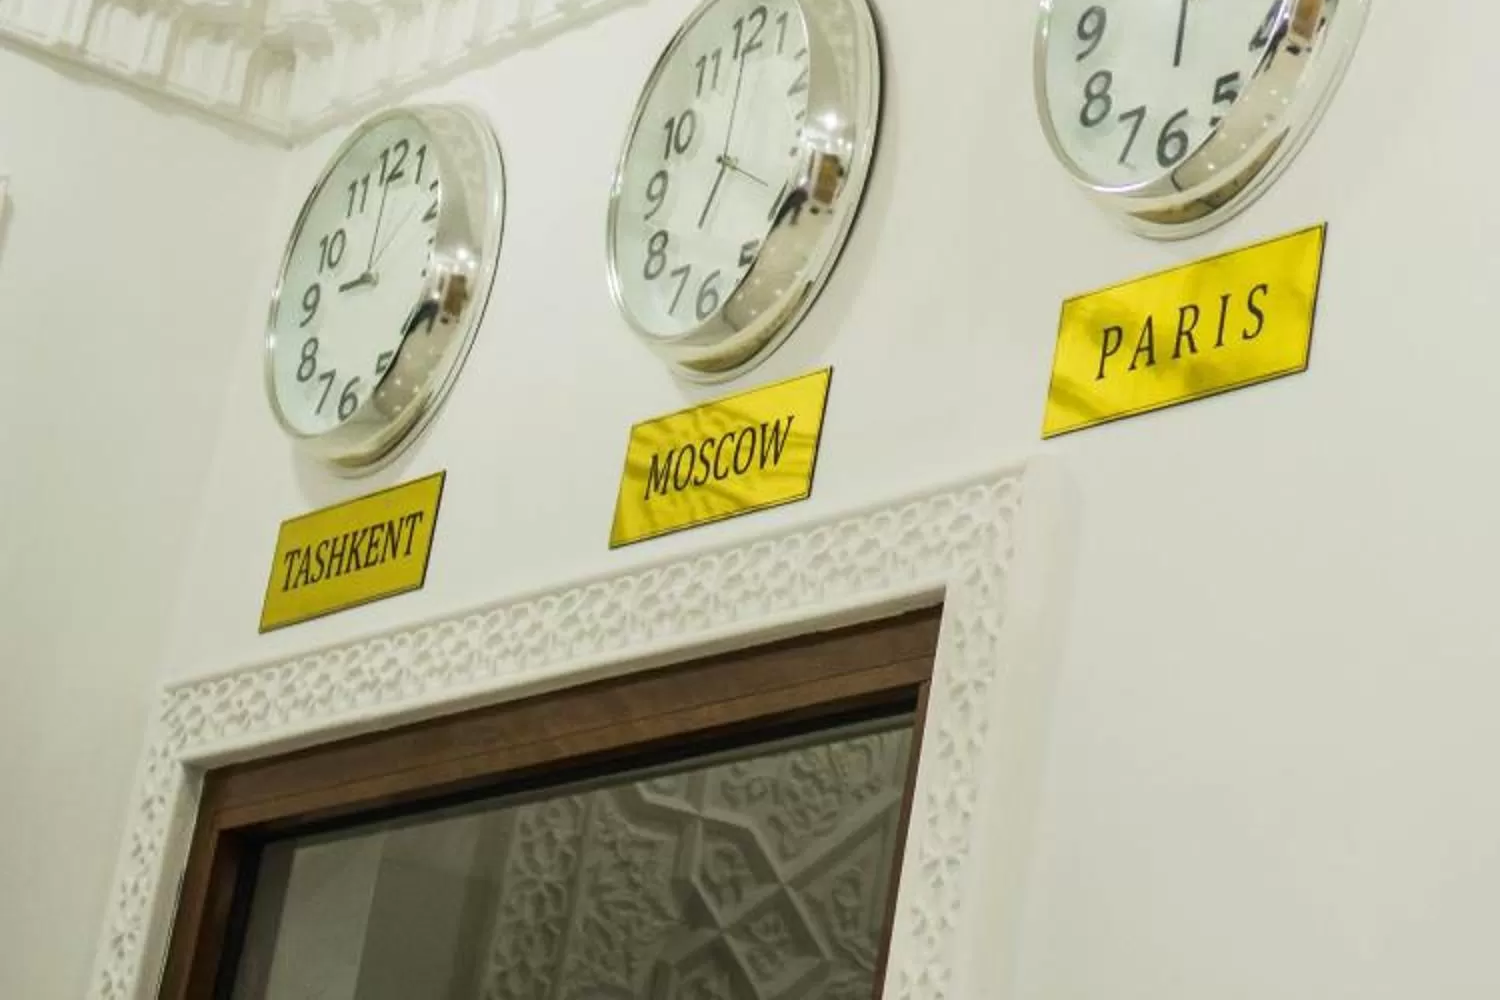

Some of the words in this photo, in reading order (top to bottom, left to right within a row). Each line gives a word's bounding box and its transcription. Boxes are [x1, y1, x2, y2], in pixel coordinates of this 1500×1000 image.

[732, 5, 767, 60] 12
[775, 12, 790, 54] 1
[1075, 5, 1106, 62] 9
[696, 48, 723, 97] 11
[1079, 70, 1113, 128] 8
[1209, 72, 1240, 128] 5
[664, 109, 696, 161] 10
[1117, 106, 1146, 164] 7
[1156, 108, 1189, 168] 6
[379, 138, 410, 187] 12
[415, 144, 428, 185] 1
[346, 173, 371, 219] 11
[644, 170, 669, 221] 9
[318, 228, 346, 274] 10
[644, 229, 669, 280] 8
[300, 283, 321, 328] 9
[668, 264, 691, 316] 7
[696, 269, 722, 322] 6
[1095, 283, 1268, 381] PARIS
[296, 336, 319, 383] 8
[315, 369, 336, 416] 7
[337, 376, 360, 422] 6
[644, 414, 795, 501] MOSCOW
[282, 510, 424, 593] TASHKENT
